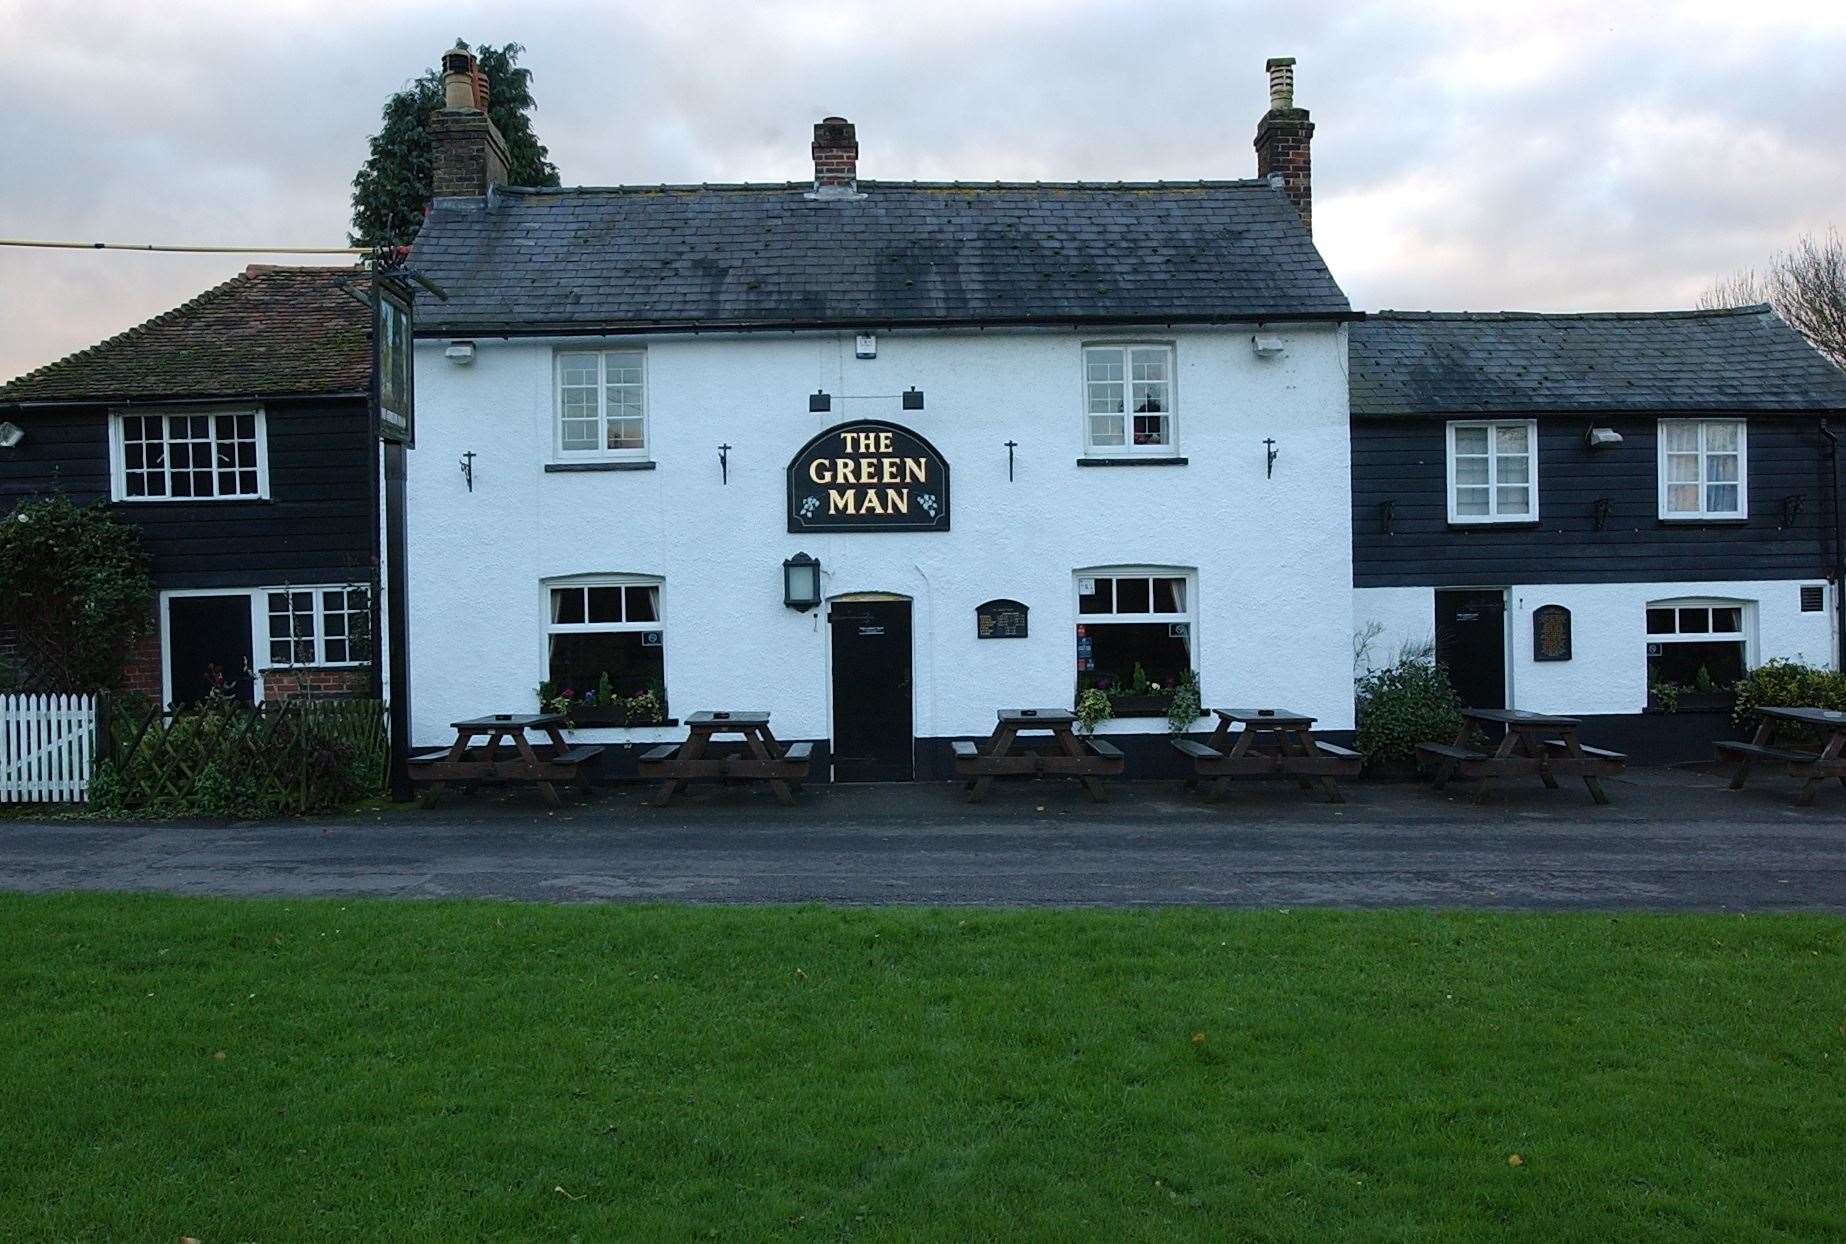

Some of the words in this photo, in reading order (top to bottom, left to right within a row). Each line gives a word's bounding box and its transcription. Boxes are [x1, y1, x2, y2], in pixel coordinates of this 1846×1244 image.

[841, 432, 893, 453] THE
[809, 457, 927, 484] GREEN
[828, 488, 909, 515] MAN
